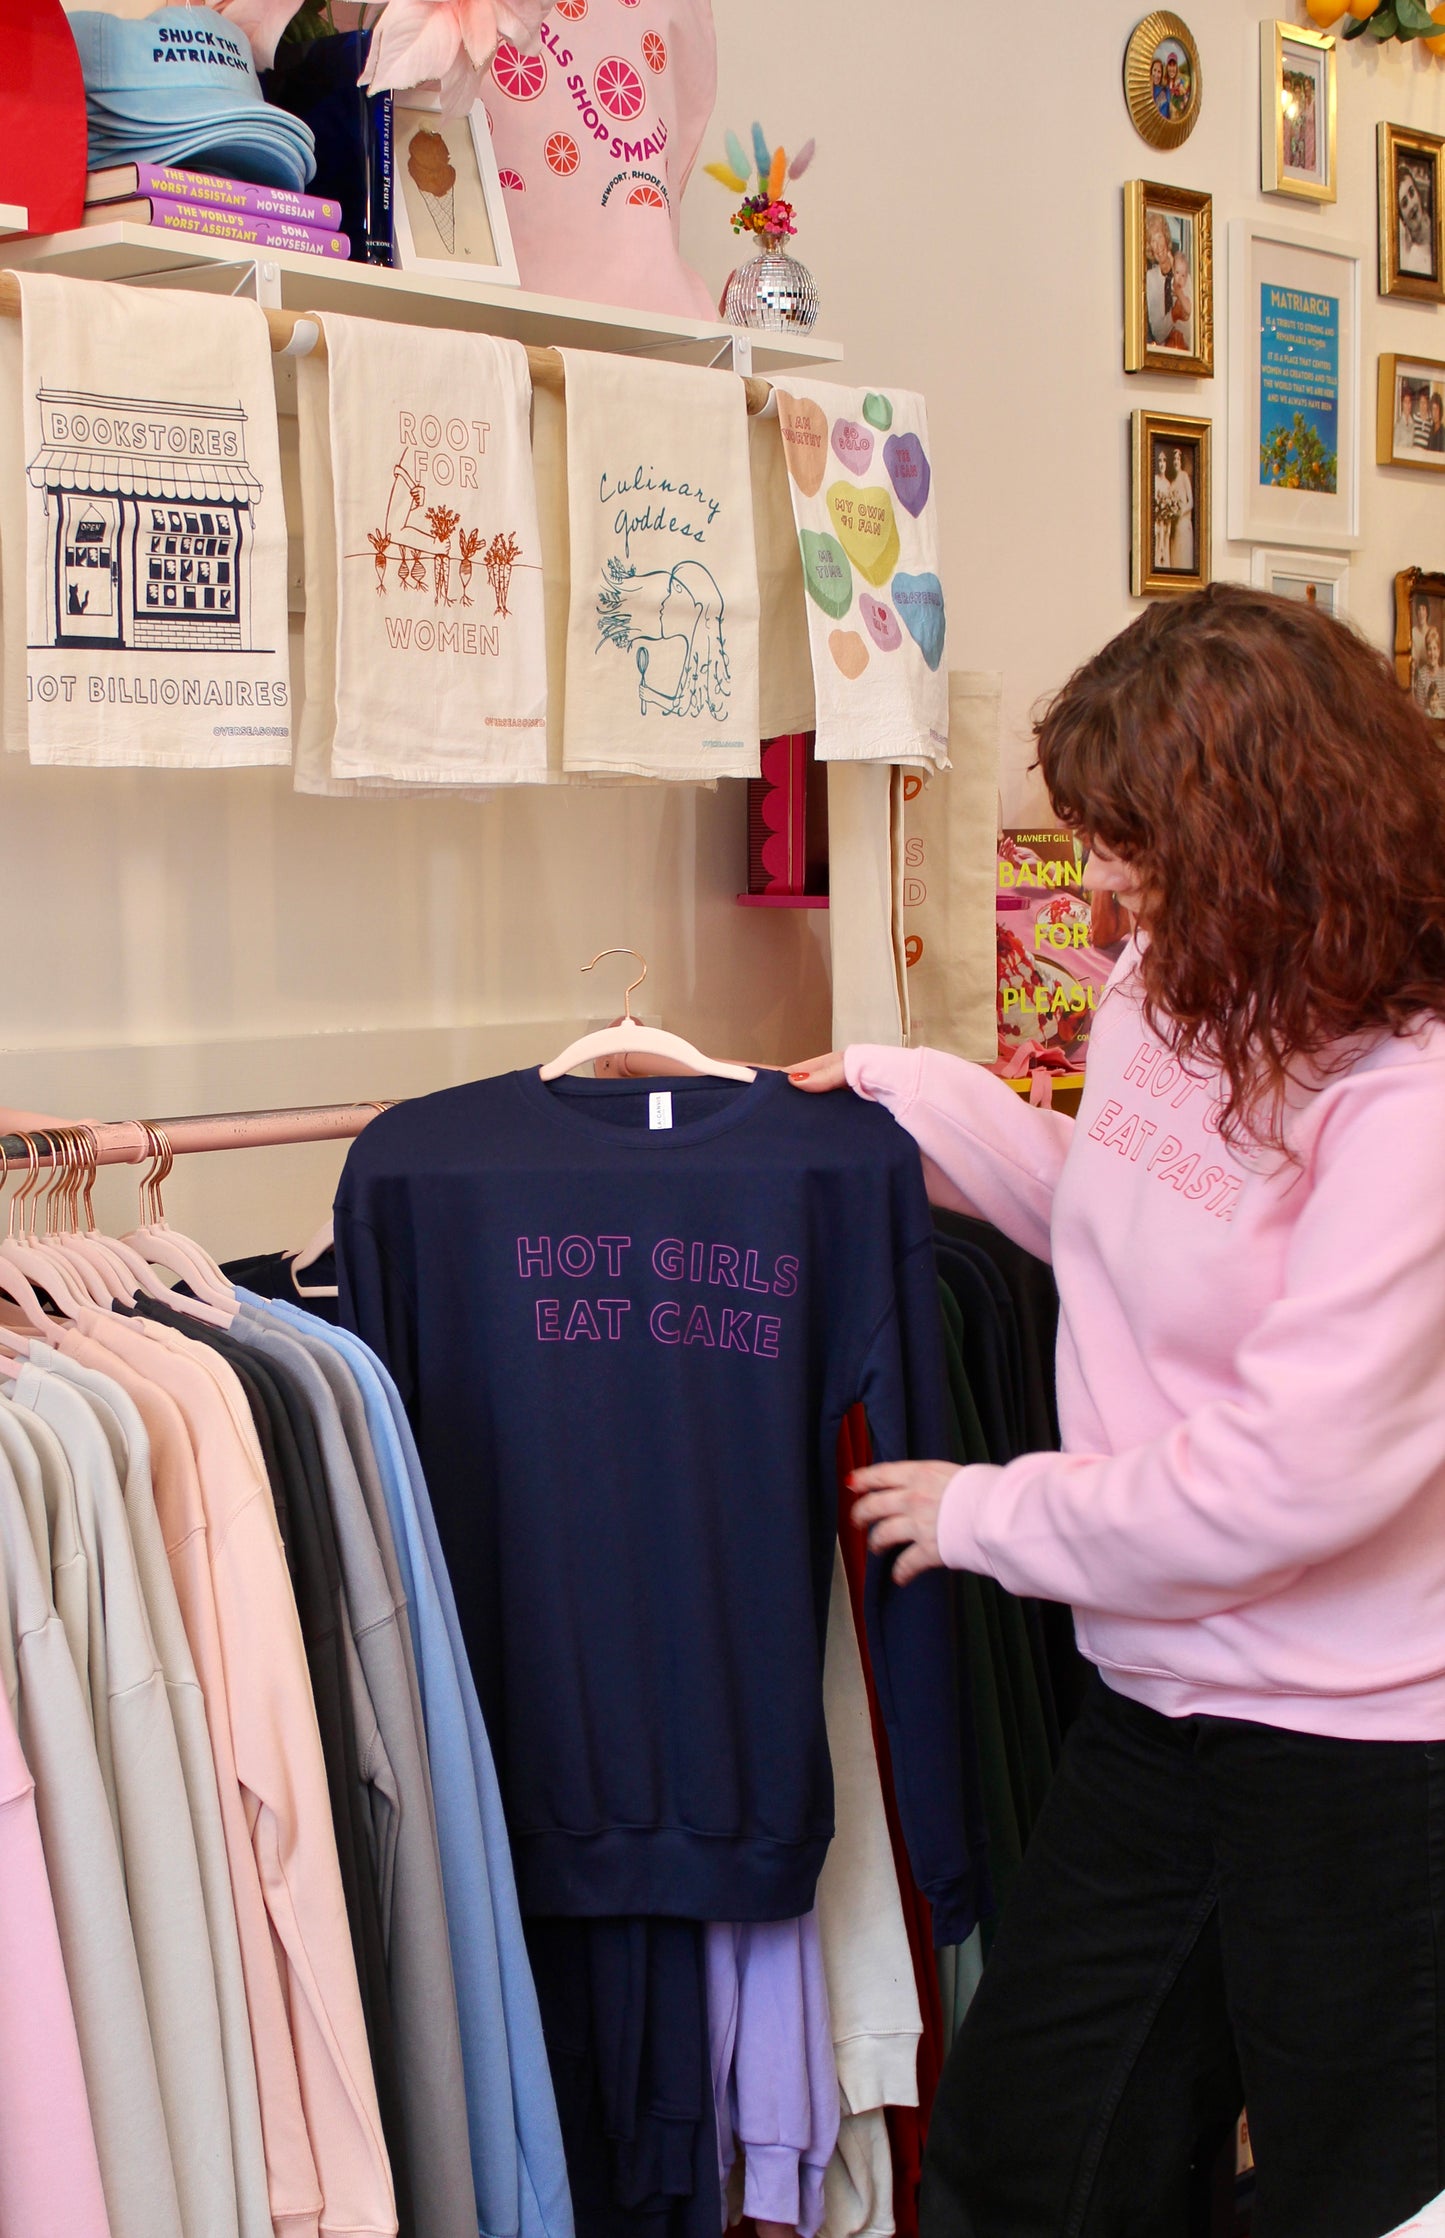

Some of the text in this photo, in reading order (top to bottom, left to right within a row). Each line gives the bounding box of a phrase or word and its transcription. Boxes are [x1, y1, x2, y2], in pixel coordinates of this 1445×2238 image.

[159, 28, 241, 56] SHUCK THE
[153, 48, 249, 74] PATRIARCHY
[384, 98, 392, 112] Un
[567, 74, 609, 141] SHOP
[610, 117, 668, 162] SMALL!
[384, 113, 392, 139] livre
[151, 179, 247, 206] WORST ASSISTANT
[163, 169, 233, 190] THE WORLD'S
[601, 171, 631, 208] NEWPORT,
[632, 170, 661, 188] RHODE
[257, 200, 315, 219] MOVSESIAN
[271, 190, 299, 204] SONA
[164, 215, 257, 242] WORST ASSISTANT
[176, 205, 244, 227] THE WORLD'S
[266, 235, 324, 254] MOVSESIAN
[281, 225, 309, 239] SONA
[1271, 289, 1330, 317] MATRIARCH
[51, 413, 238, 457] BOOKSTORES
[399, 411, 491, 454] ROOT
[795, 416, 811, 430] AM
[781, 428, 821, 448] WORTHY
[838, 437, 870, 451] SOLO
[414, 450, 478, 489] FOR
[600, 466, 721, 524] Culinary
[834, 498, 886, 522] MY OWN
[81, 523, 100, 532] OPEN
[858, 519, 882, 536] FAN
[818, 550, 833, 563] ME
[816, 565, 843, 579] TIME
[385, 617, 500, 656] WOMEN
[89, 676, 288, 707] BILLIONAIRES
[1016, 834, 1070, 843] RAVNEET GILL
[999, 860, 1088, 888] BAKIN
[1034, 922, 1089, 950] FOR
[1123, 1042, 1209, 1109] HOT
[1088, 1099, 1158, 1161] EAT
[517, 1235, 800, 1297] HOT GIRLS
[536, 1299, 781, 1359] EAT CAKE
